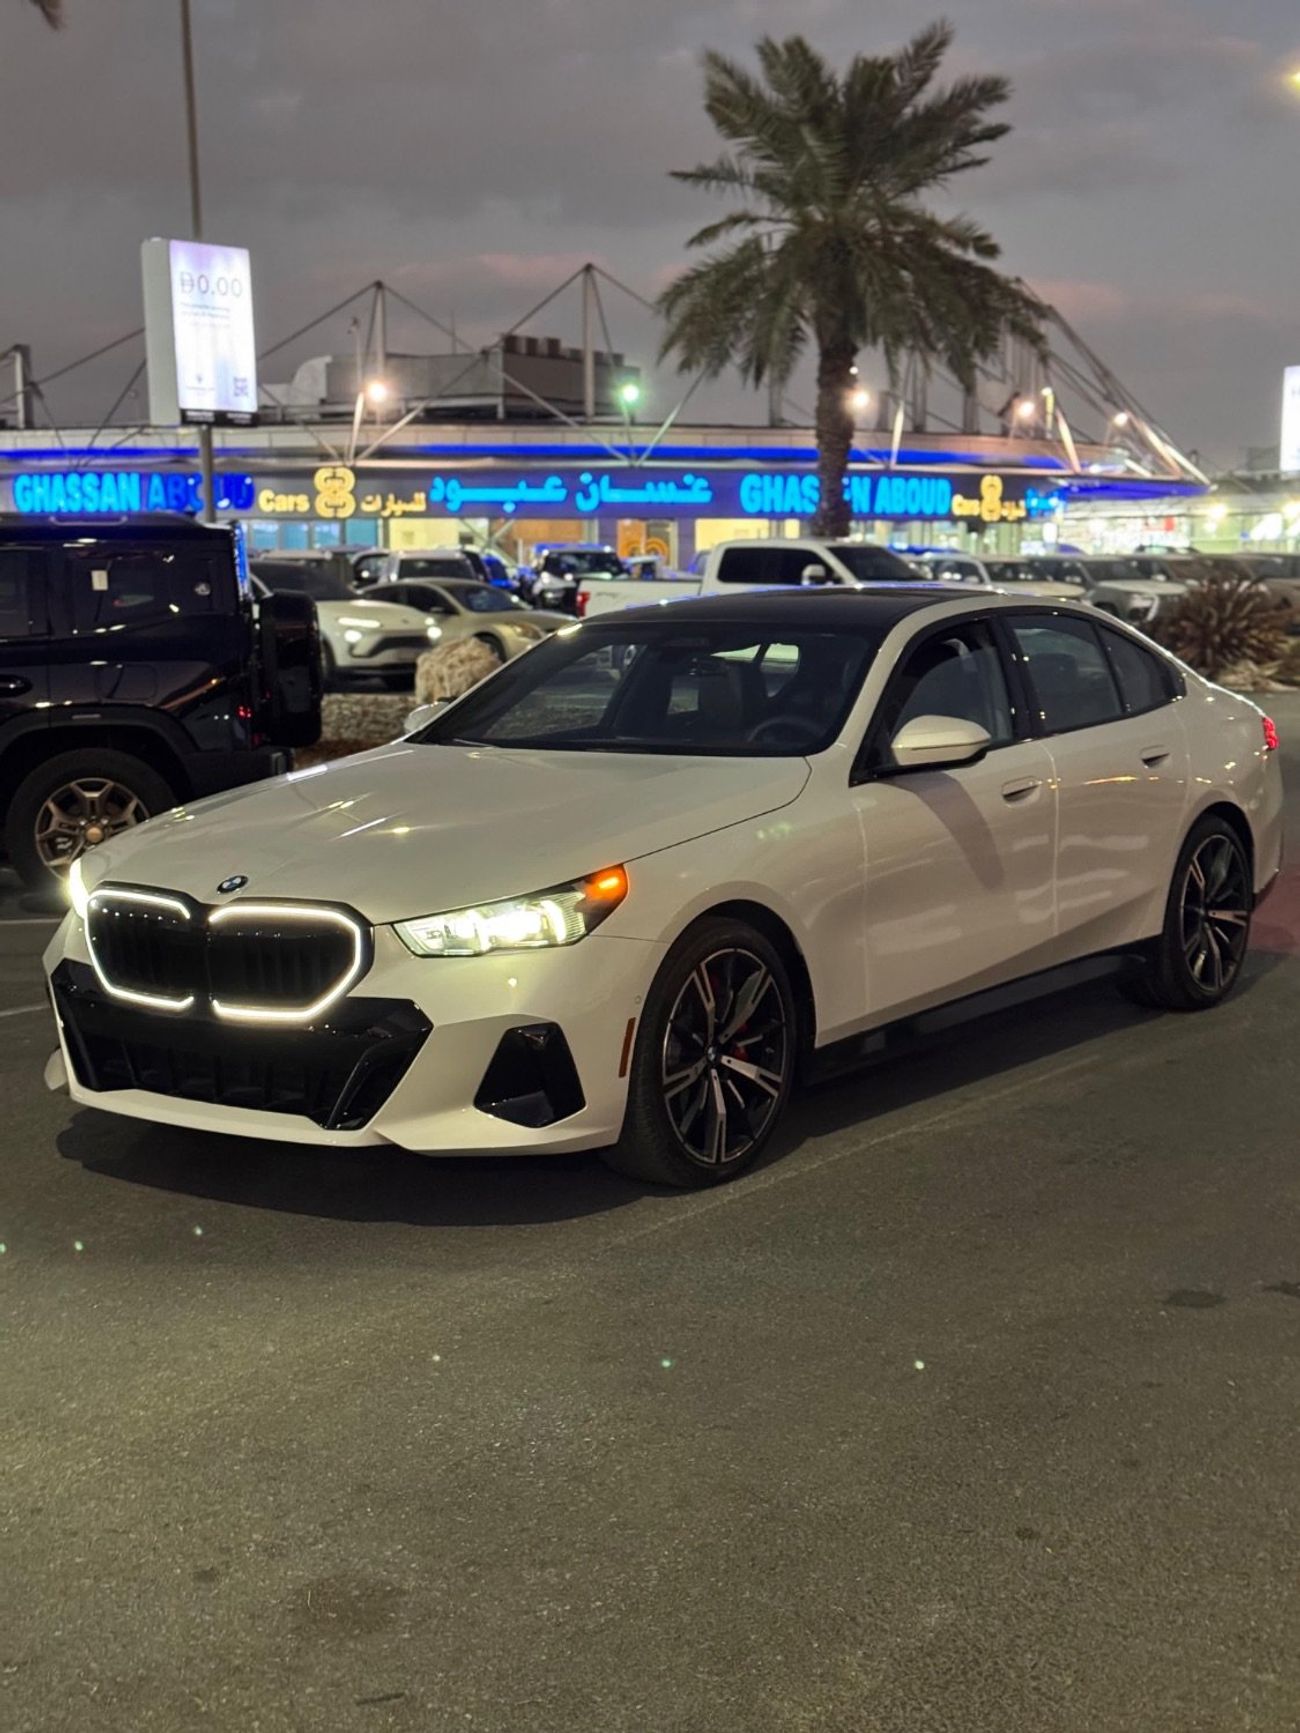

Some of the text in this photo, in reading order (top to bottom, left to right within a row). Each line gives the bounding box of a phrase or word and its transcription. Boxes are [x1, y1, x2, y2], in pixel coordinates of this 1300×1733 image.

[14, 473, 140, 512] GHASSAN
[258, 489, 310, 512] Cars
[429, 476, 567, 513] عبود
[575, 472, 713, 512] غسان
[740, 474, 871, 514] GHASN
[874, 476, 951, 515] ABOUD
